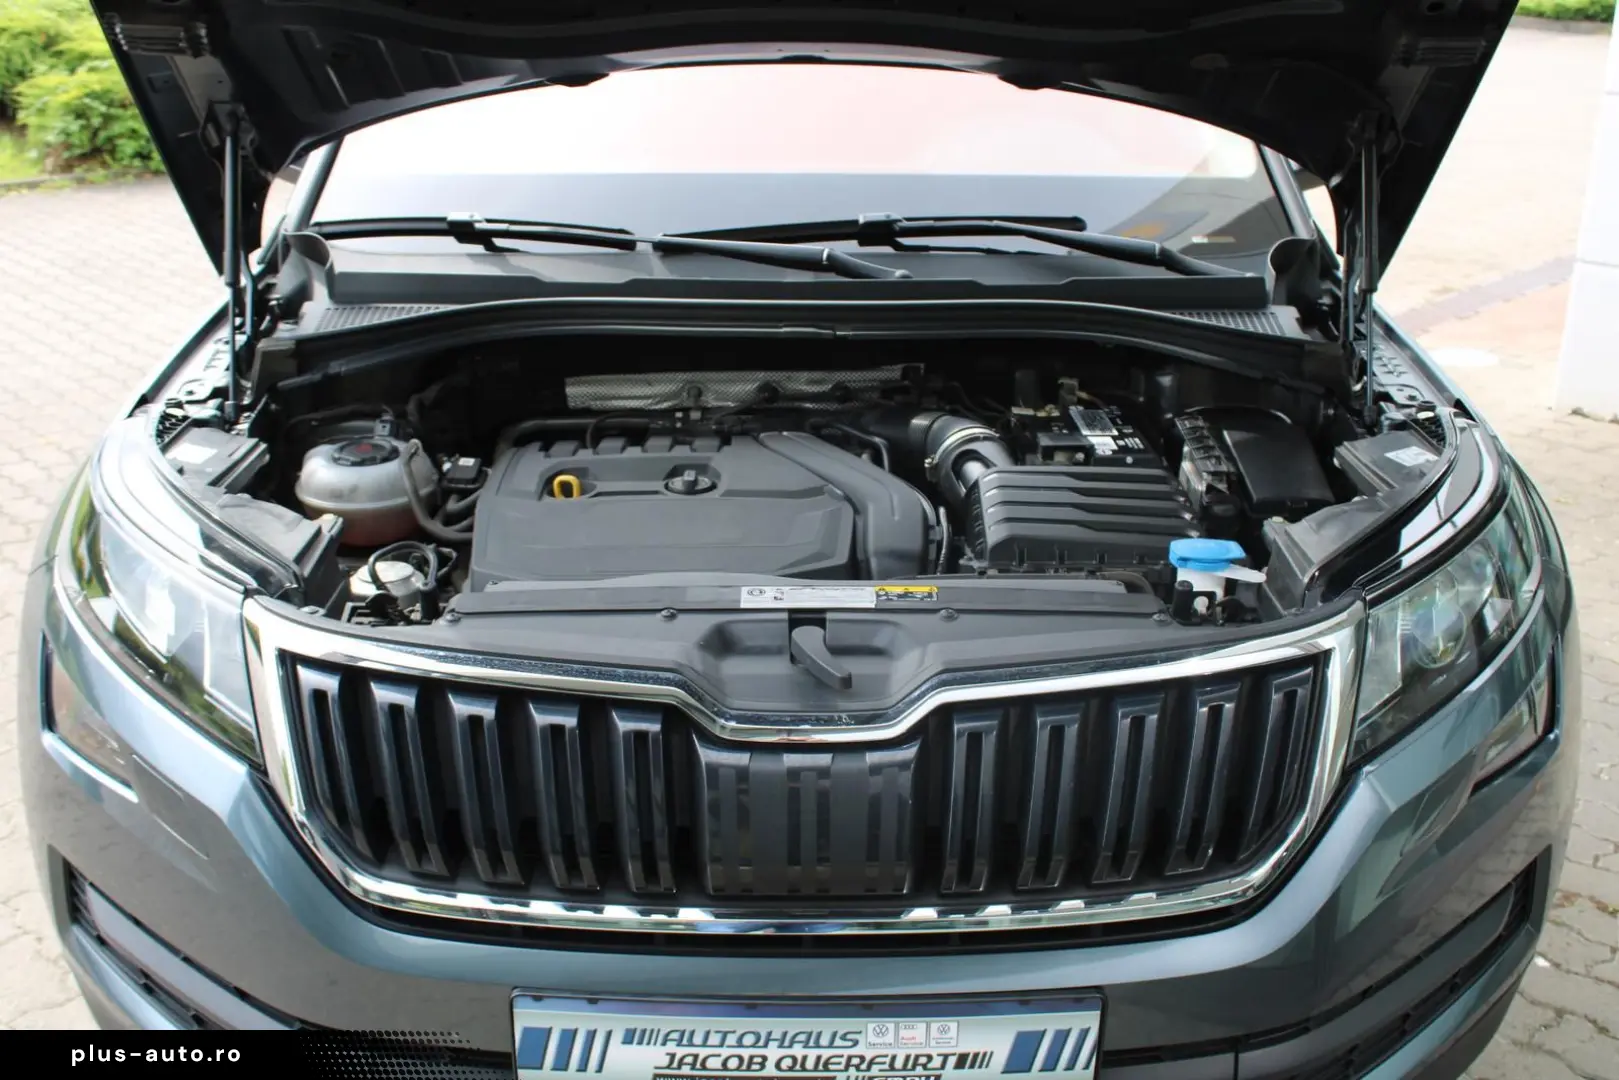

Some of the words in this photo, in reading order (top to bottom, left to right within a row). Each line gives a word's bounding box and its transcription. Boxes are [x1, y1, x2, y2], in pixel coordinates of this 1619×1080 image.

[660, 1028, 862, 1049] AUTOHAUS
[653, 1052, 769, 1072] JACOB
[773, 1052, 957, 1072] QUERFURT
